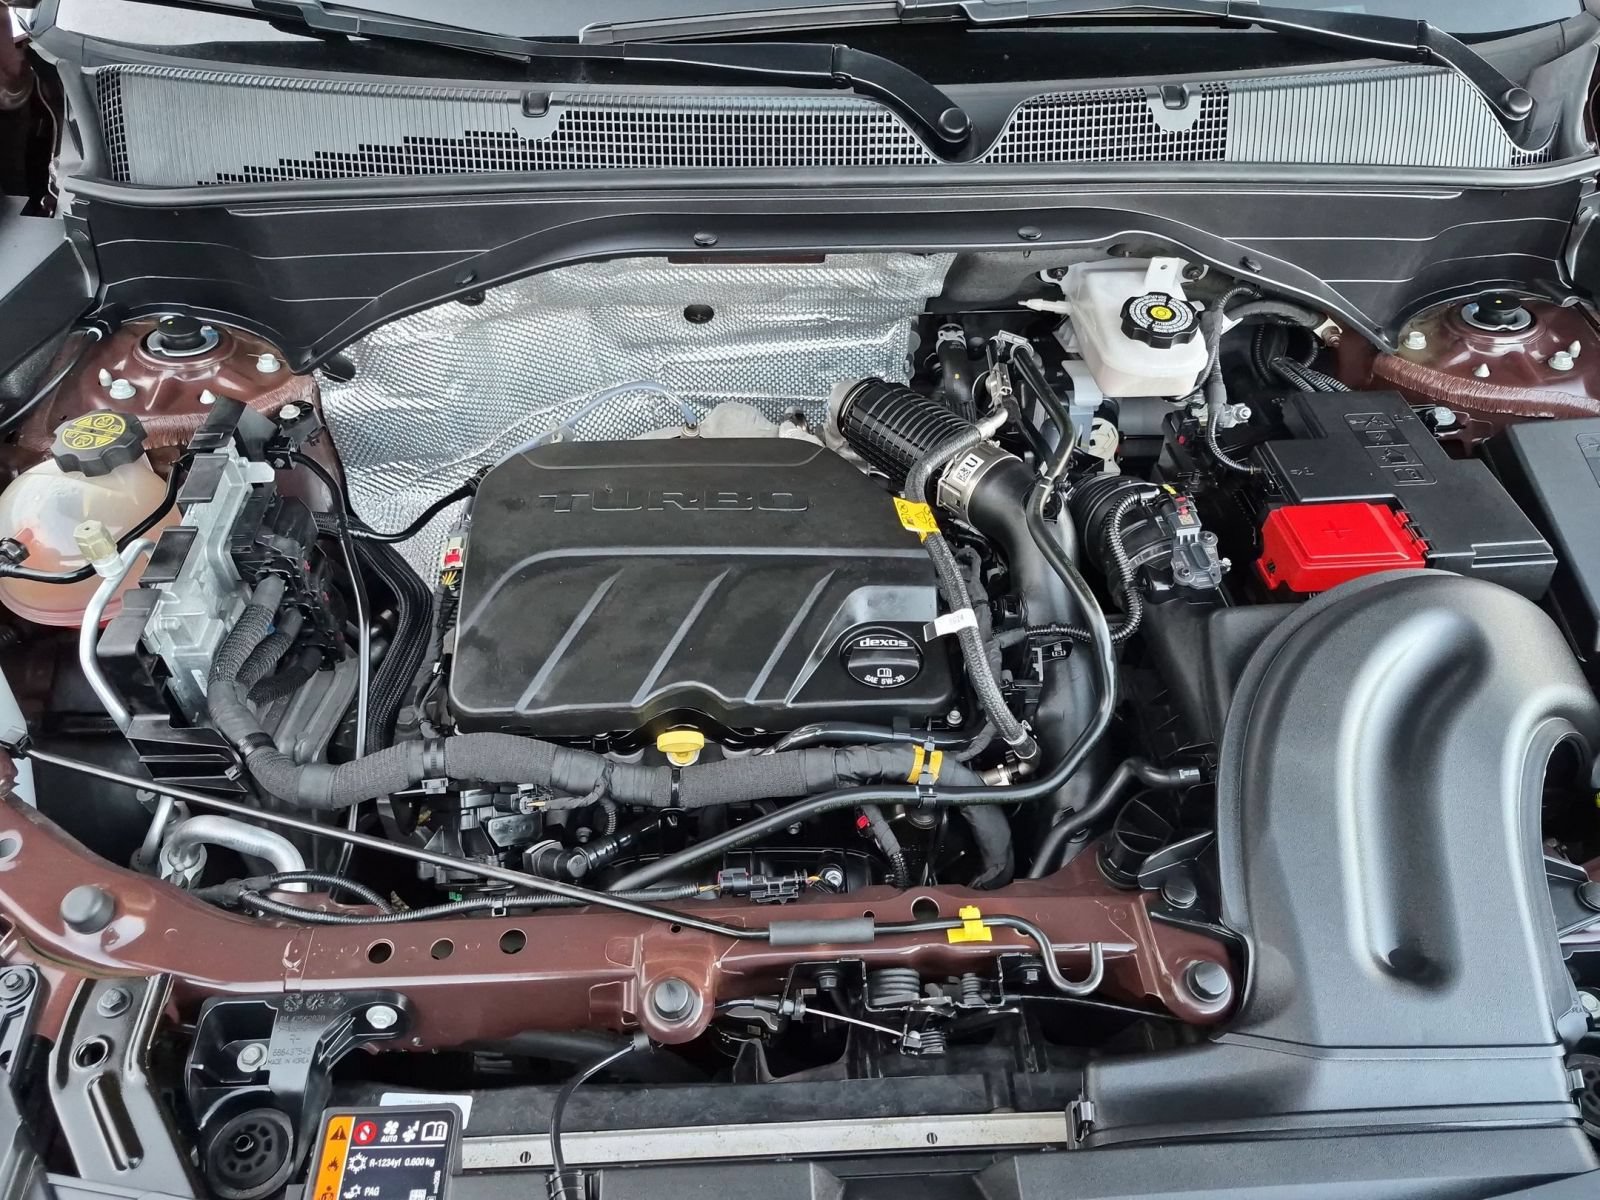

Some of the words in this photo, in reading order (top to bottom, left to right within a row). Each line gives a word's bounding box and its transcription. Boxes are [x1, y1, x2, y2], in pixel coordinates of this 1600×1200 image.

[538, 490, 808, 513] TURBO
[859, 637, 909, 647] dexos
[864, 674, 878, 684] SAE
[880, 674, 906, 685] 5W-30
[380, 1135, 398, 1143] AUTO
[369, 1157, 402, 1168] R-1234yf
[404, 1157, 424, 1166] 0.600
[425, 1157, 435, 1167] kg
[364, 1186, 380, 1197] PAG
